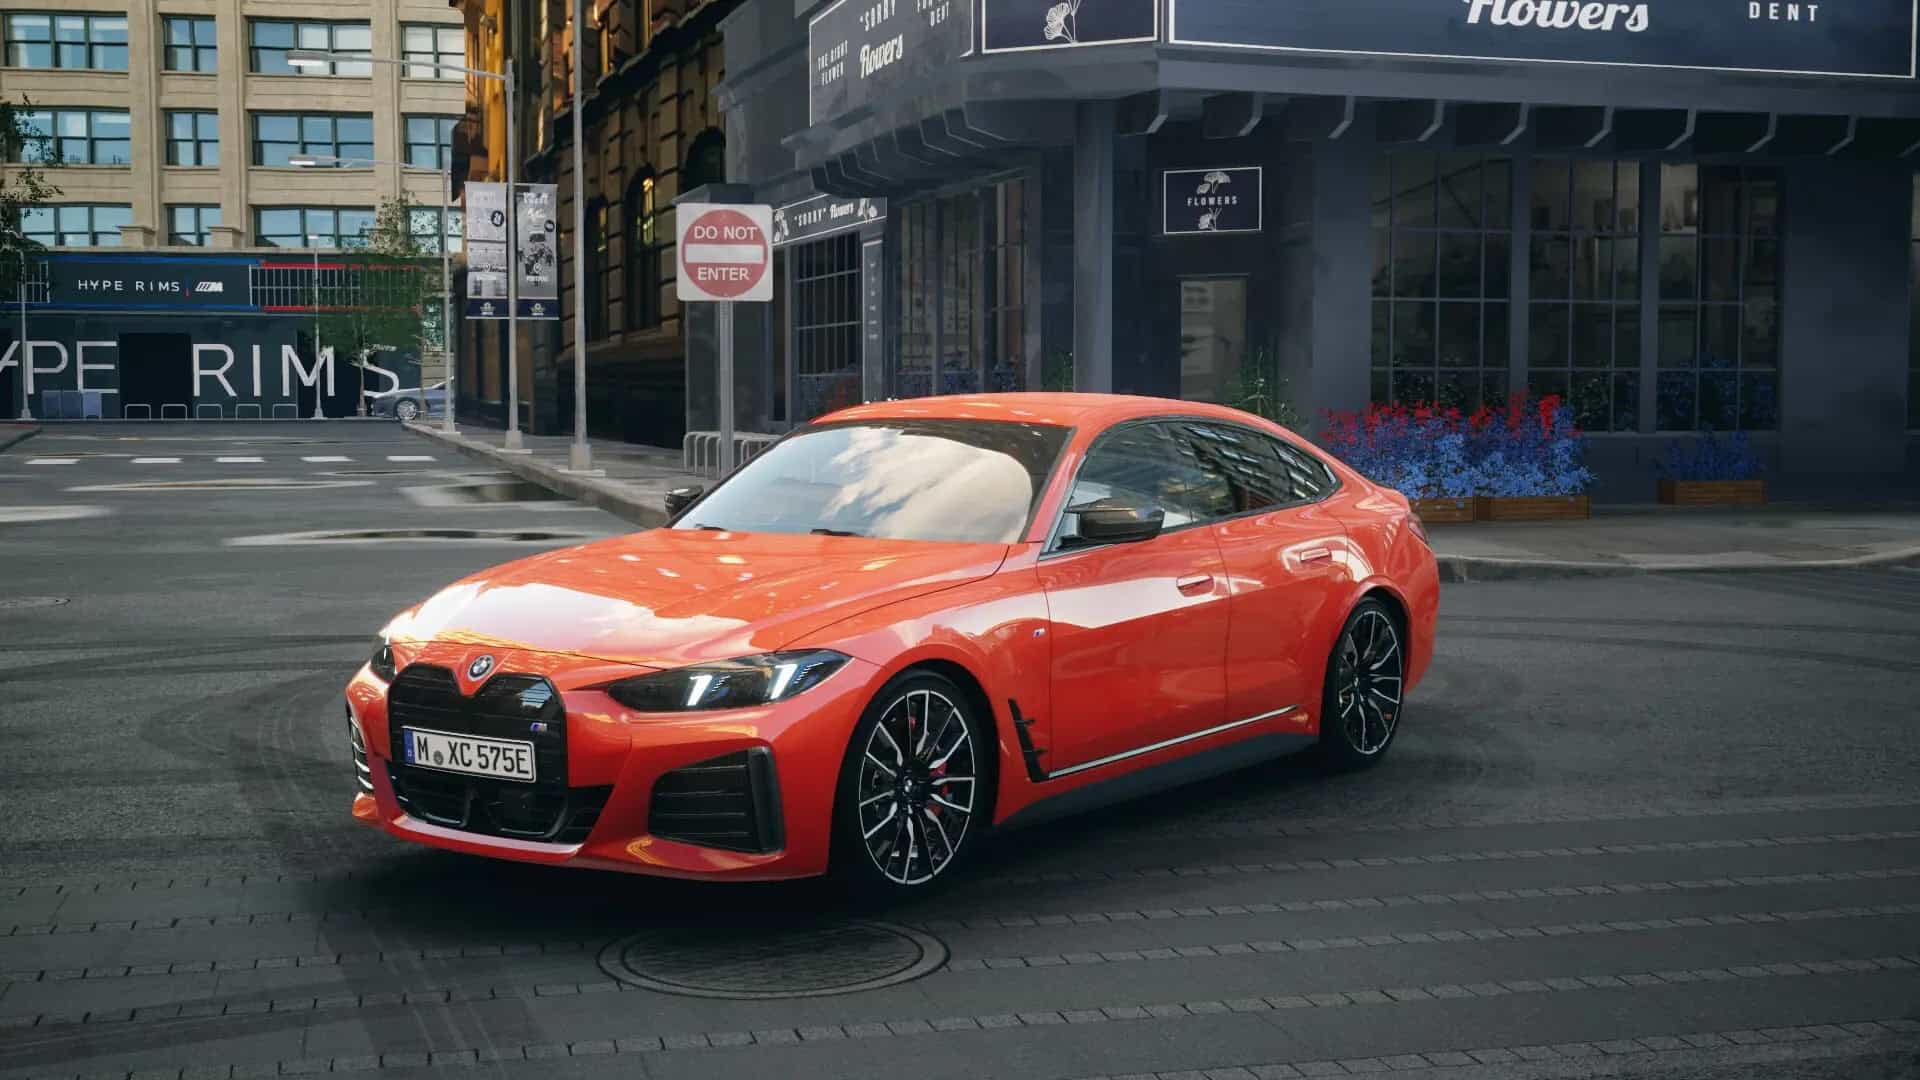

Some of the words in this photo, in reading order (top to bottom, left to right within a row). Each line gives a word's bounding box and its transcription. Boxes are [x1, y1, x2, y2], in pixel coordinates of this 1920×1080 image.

[1749, 1, 1818, 21] DENT
[860, 33, 903, 79] Flowers
[1187, 195, 1238, 207] FLOWERS
[694, 225, 718, 240] DO
[723, 225, 758, 240] NOT
[697, 266, 750, 281] ENTER
[78, 279, 124, 292] HYPE
[135, 280, 180, 292] RIMS
[192, 342, 399, 398] RIMS
[416, 735, 429, 761] M
[448, 741, 472, 767] XC
[476, 744, 529, 774] 575E
